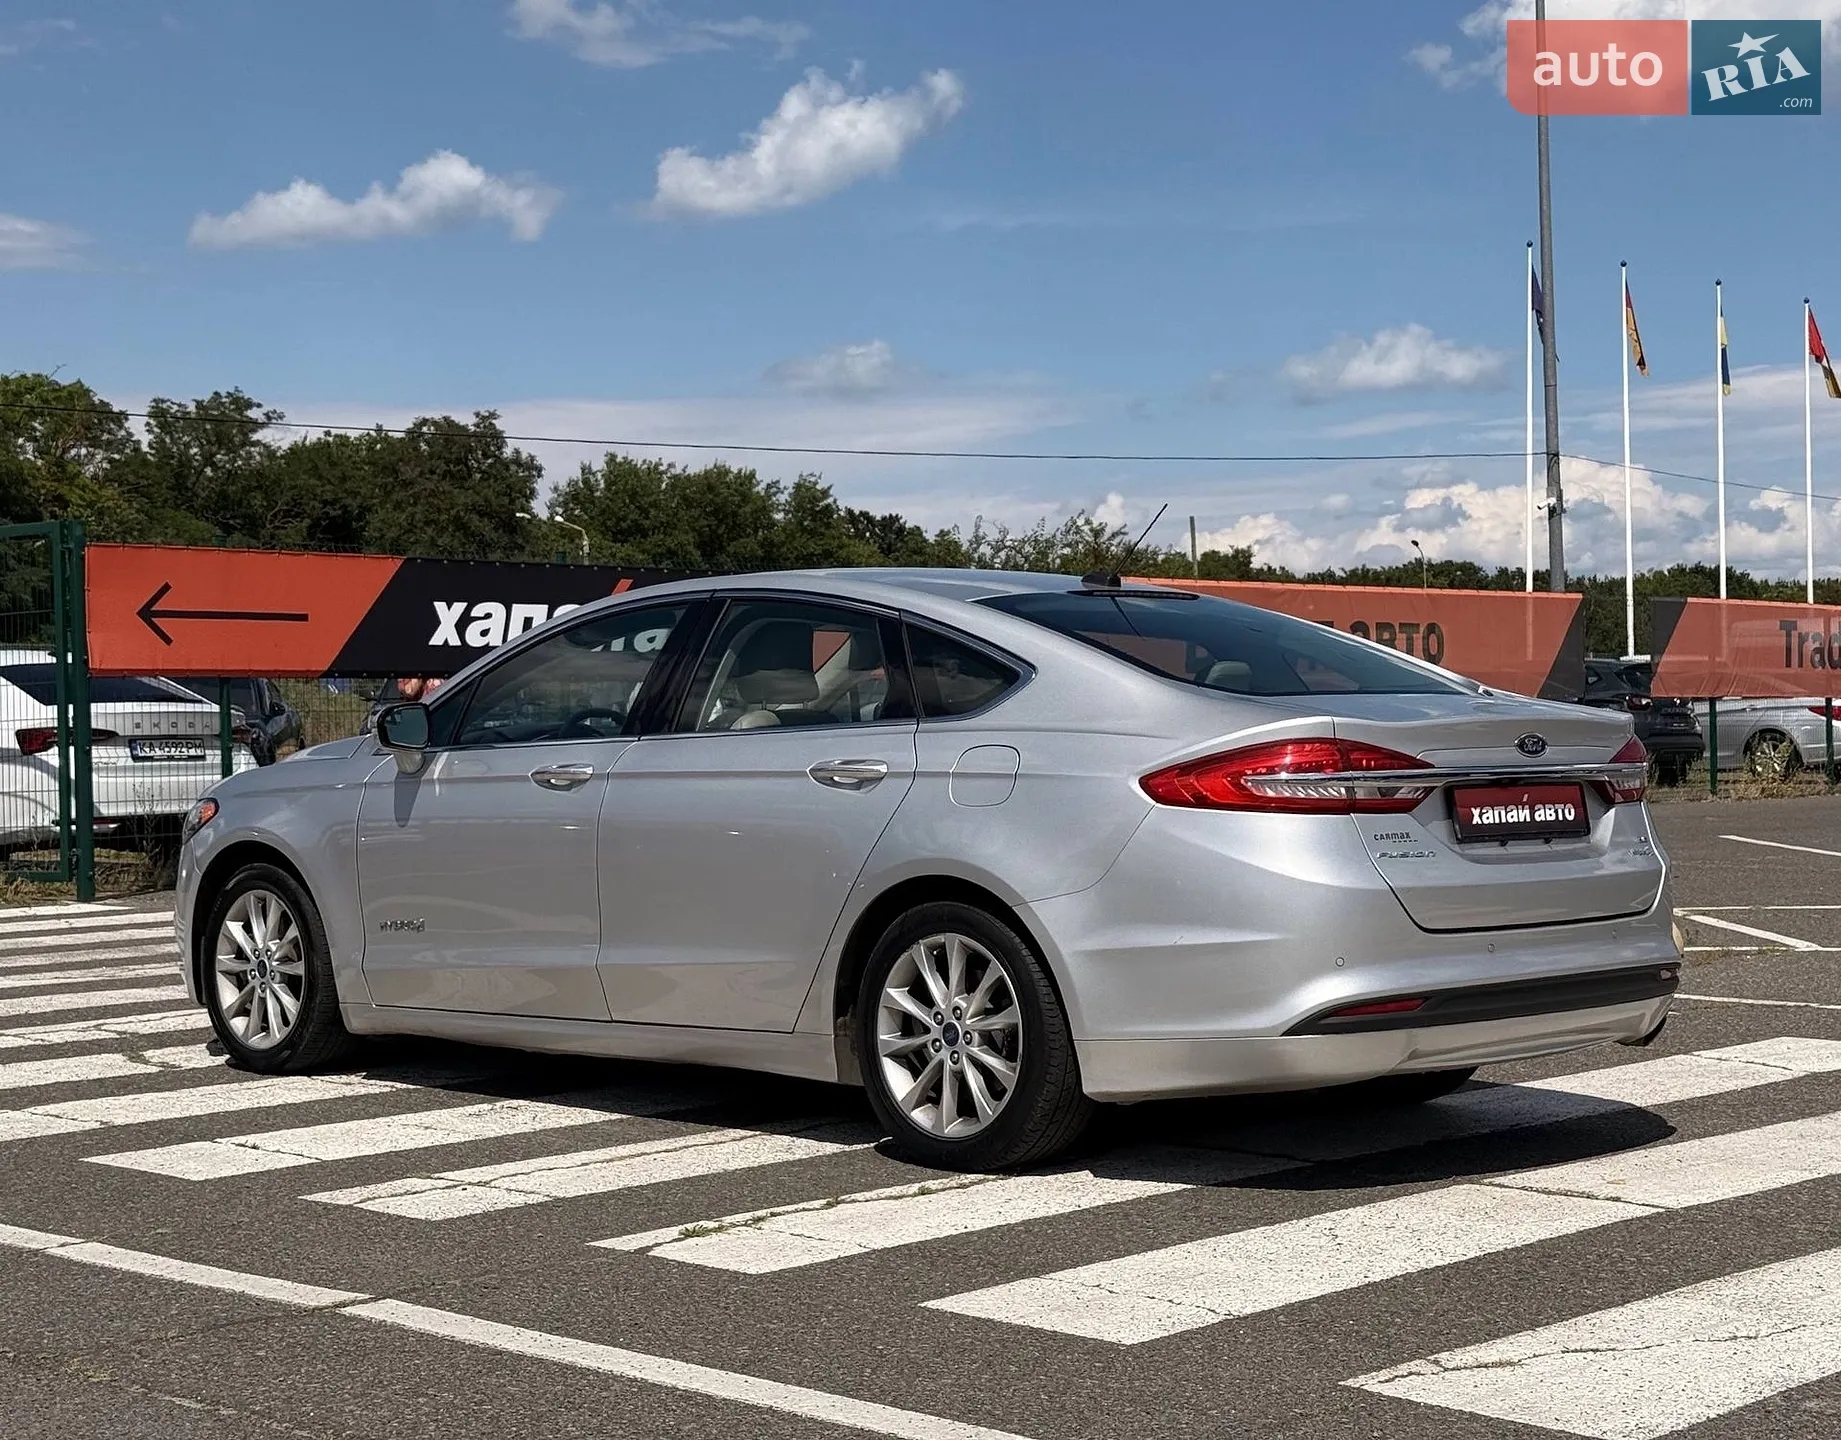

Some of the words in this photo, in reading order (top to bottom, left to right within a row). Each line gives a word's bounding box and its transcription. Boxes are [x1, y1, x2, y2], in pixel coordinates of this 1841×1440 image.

[1779, 619, 1841, 670] Trad
[1471, 793, 1531, 825] хапай
[1534, 803, 1575, 821] авто
